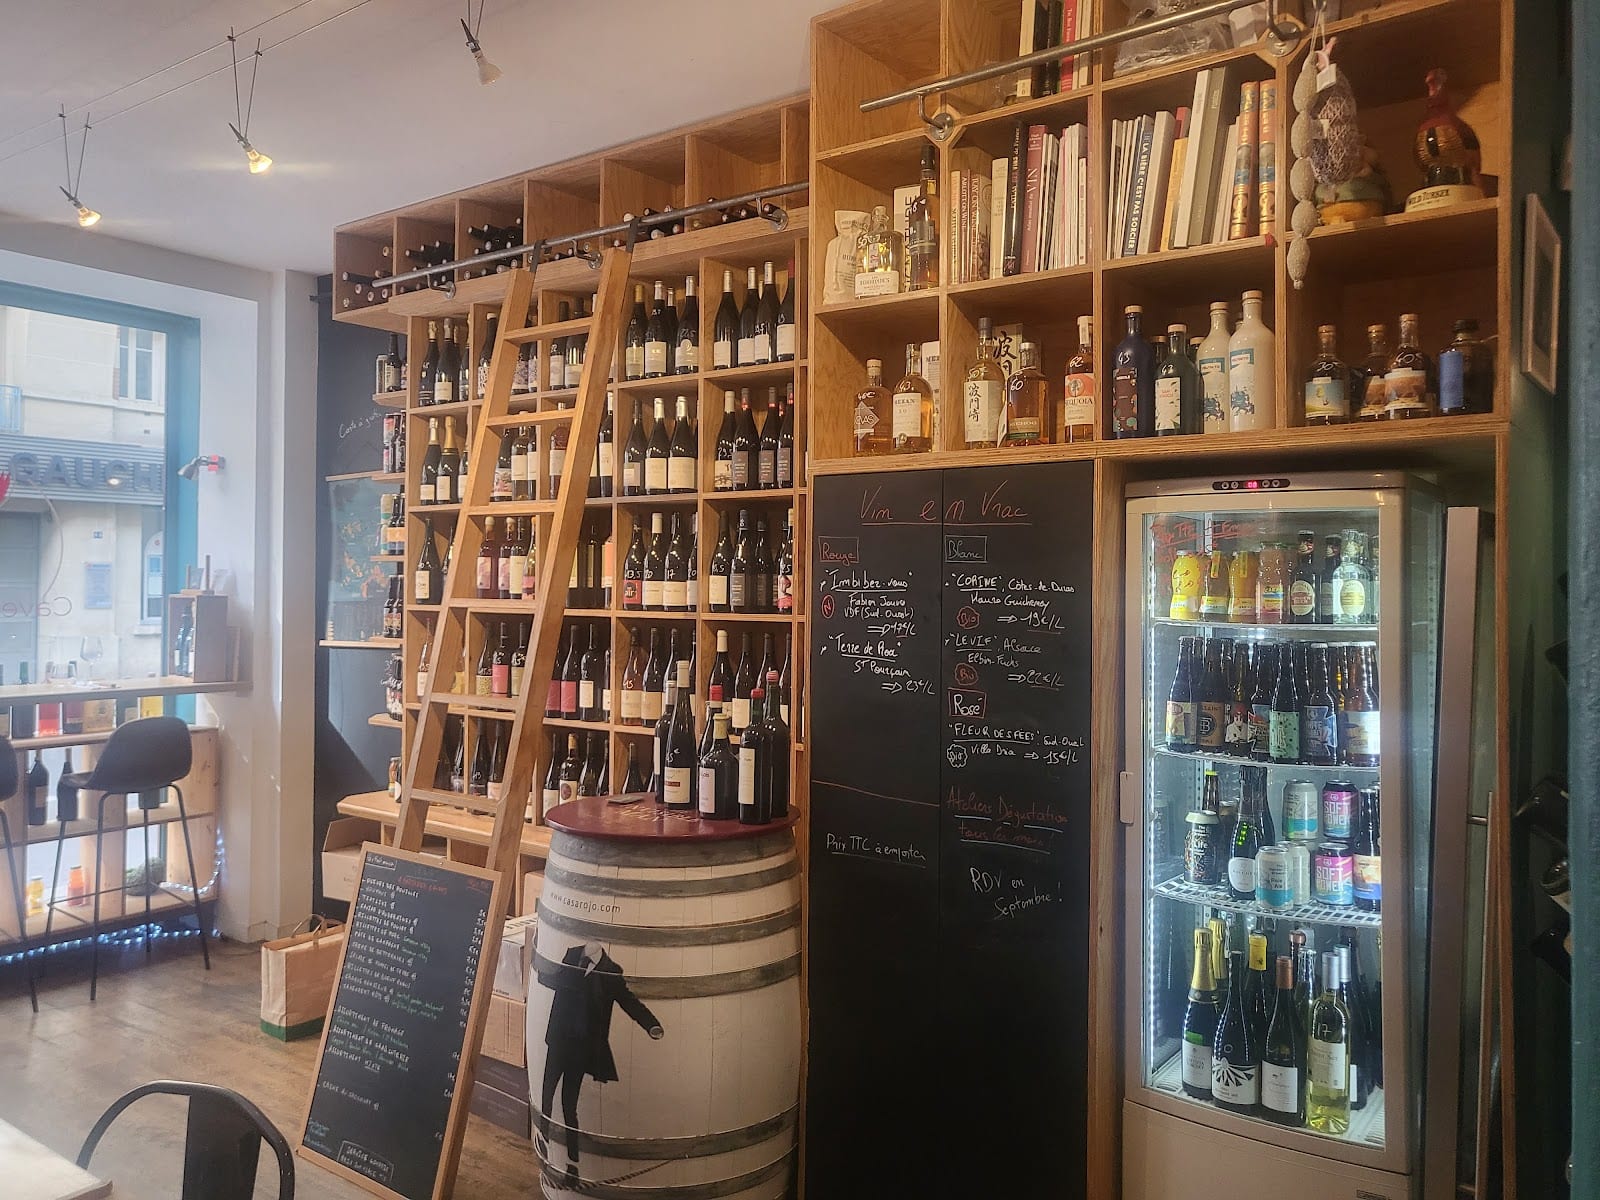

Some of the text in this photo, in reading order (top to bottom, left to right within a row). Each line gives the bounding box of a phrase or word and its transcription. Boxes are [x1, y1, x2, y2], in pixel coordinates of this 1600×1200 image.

[1142, 142, 1150, 155] LA
[1027, 168, 1038, 193] VIN
[1133, 200, 1142, 214] PAS
[1127, 216, 1138, 249] SORCIER
[860, 486, 894, 520] Vin
[981, 480, 1029, 518] Vrac
[822, 542, 856, 566] Rouge
[949, 540, 983, 560] Blanc
[864, 642, 874, 655] de
[954, 693, 983, 716] Rosé
[946, 786, 993, 815] Ateliers
[1324, 800, 1349, 814] SOFT
[826, 832, 848, 852] Prix
[849, 834, 872, 851] TTC
[969, 866, 1025, 893] RDV en
[1316, 866, 1343, 881] SOFT
